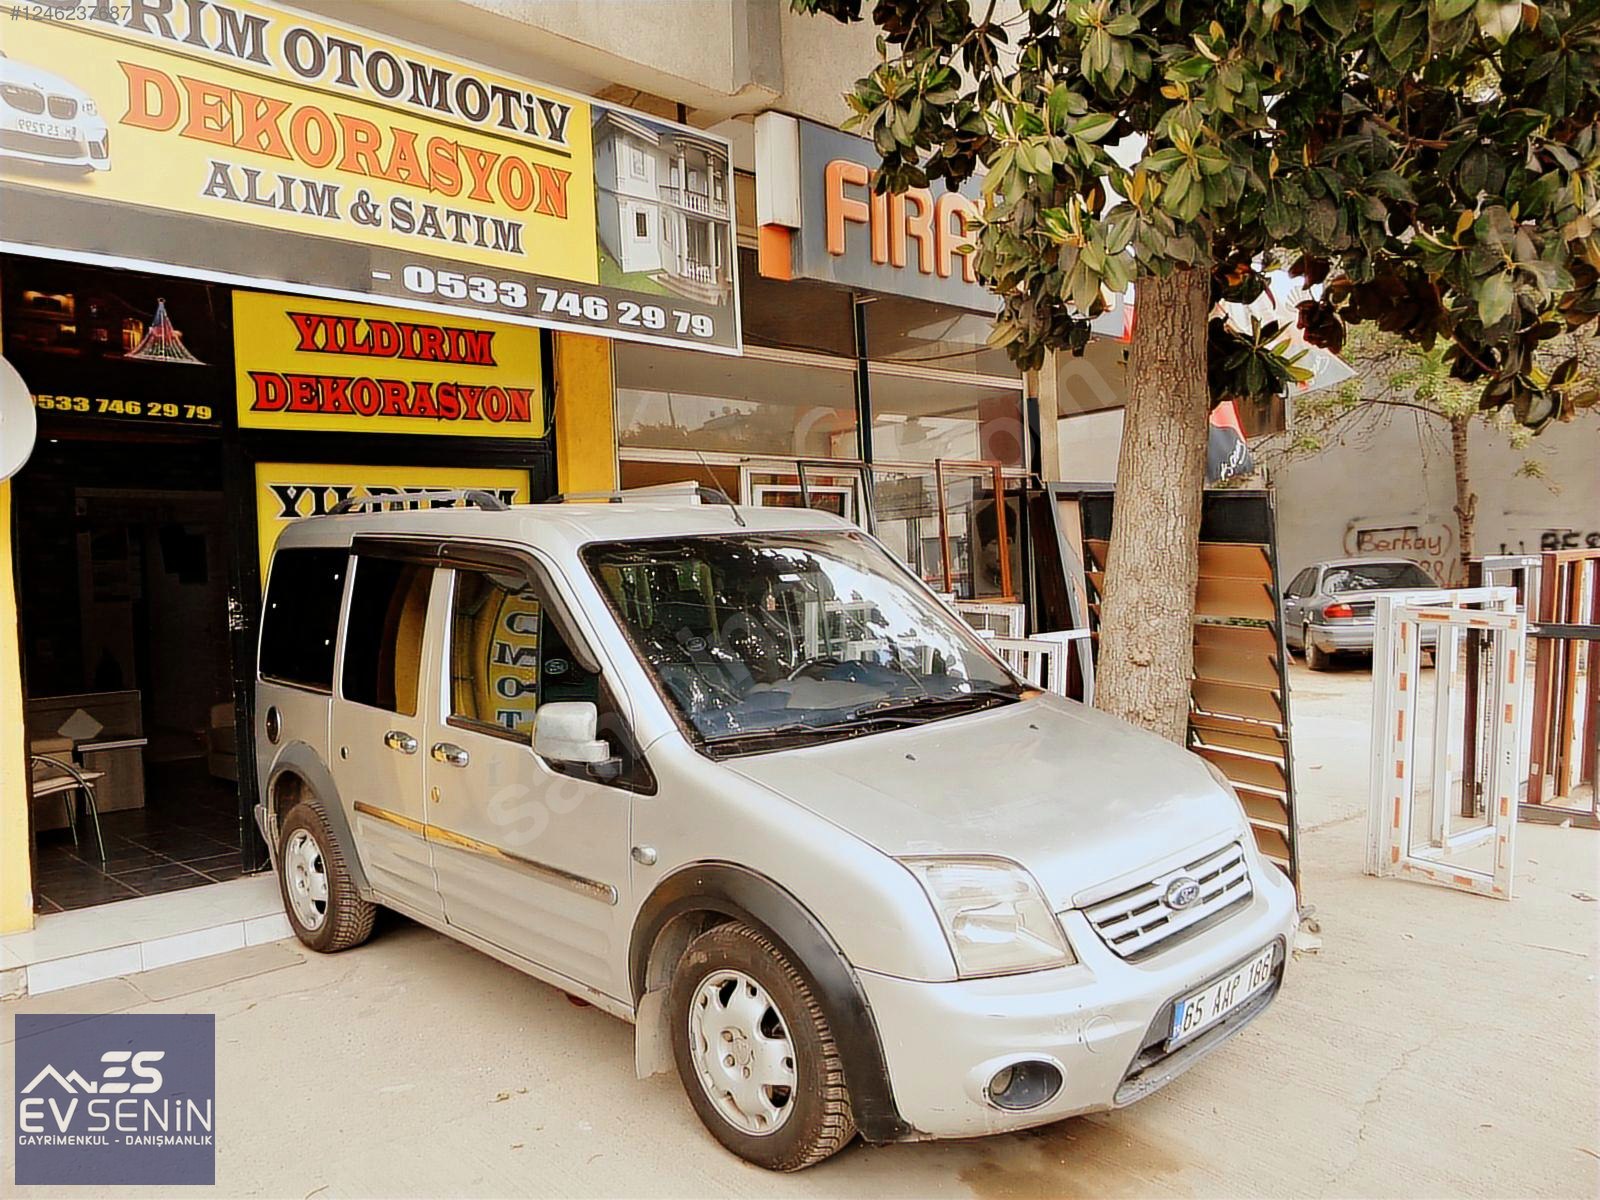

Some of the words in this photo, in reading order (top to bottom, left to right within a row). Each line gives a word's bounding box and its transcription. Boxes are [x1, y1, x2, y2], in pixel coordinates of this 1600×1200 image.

[117, 60, 572, 219] DEKORASYON
[203, 160, 341, 219] ALIM
[350, 190, 381, 227] &
[391, 197, 524, 254] SATIM
[404, 264, 527, 309] 0533
[536, 288, 608, 321] 746
[617, 301, 665, 330] 29
[672, 310, 714, 339] 79
[286, 312, 497, 366] YILDIRIM
[96, 398, 141, 415] 746
[147, 402, 179, 418] 29
[184, 404, 212, 420] 79
[248, 371, 534, 422] DEKORASYON
[1183, 996, 1205, 1032] 65
[1212, 975, 1241, 1017] AAP
